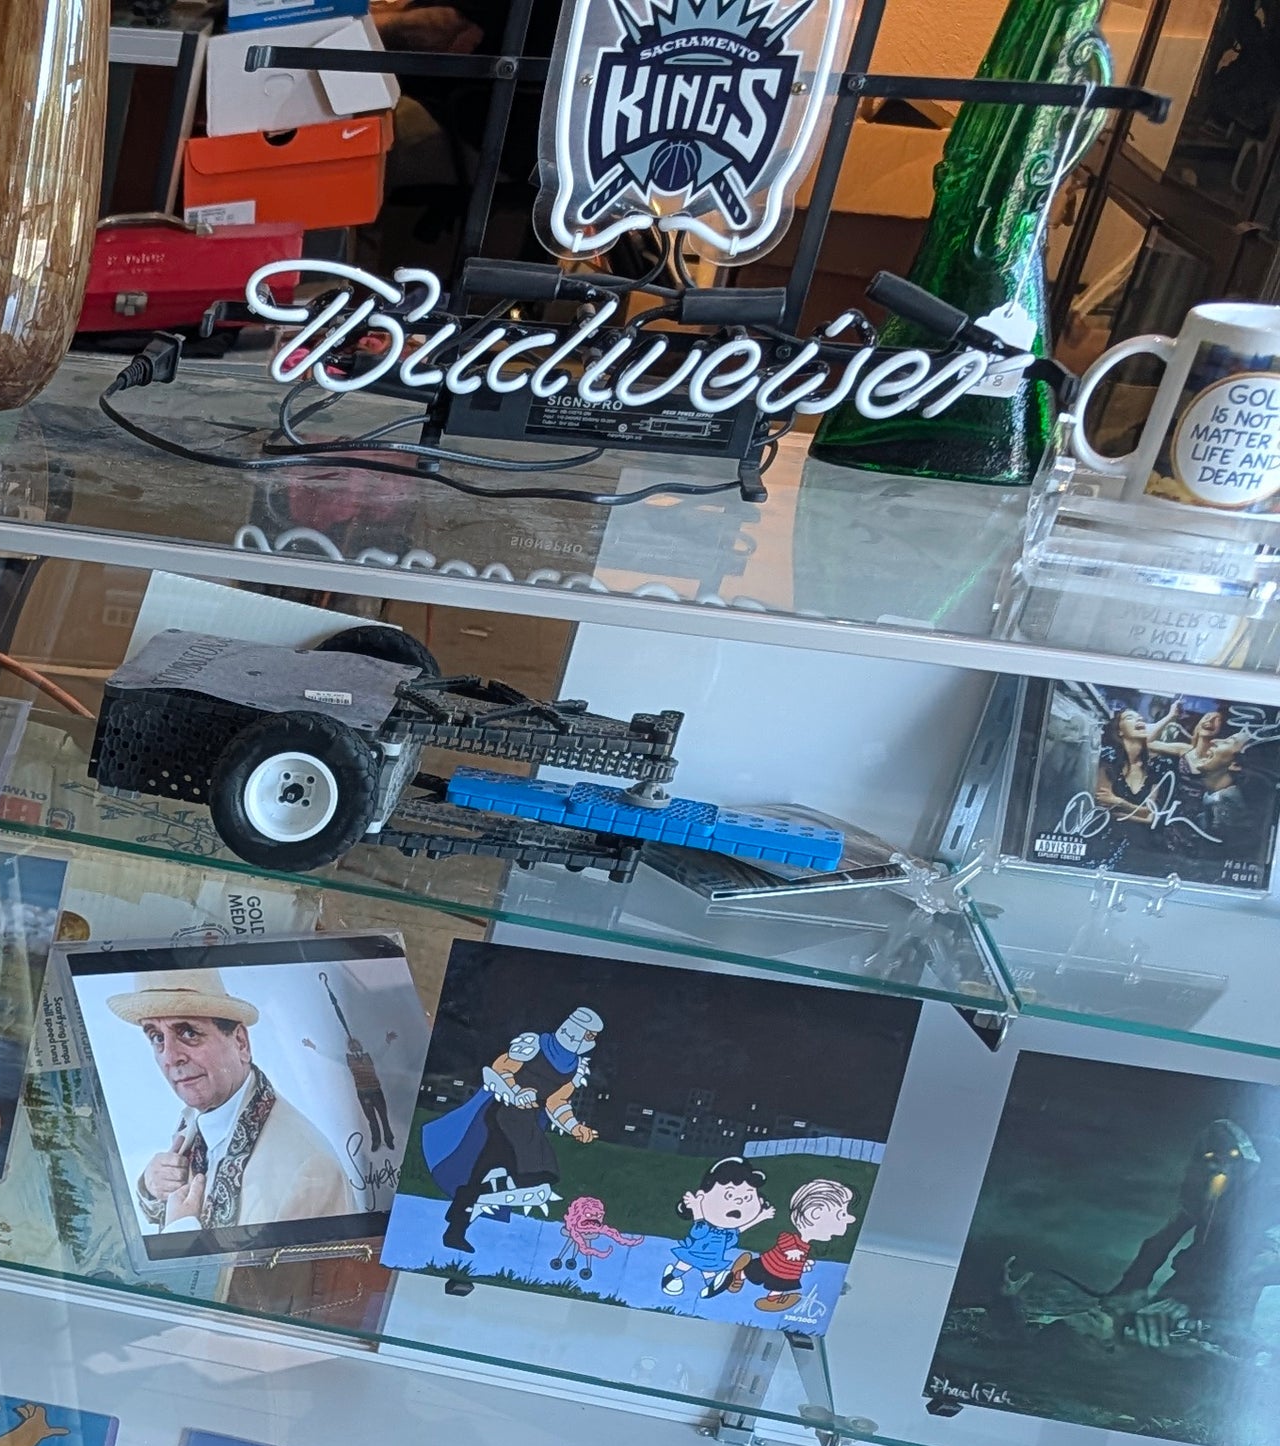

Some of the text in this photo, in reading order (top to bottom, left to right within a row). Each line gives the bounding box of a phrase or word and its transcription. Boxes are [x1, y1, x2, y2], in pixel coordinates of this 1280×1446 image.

[639, 35, 761, 63] SACRAMENTO
[600, 65, 784, 164] KINGS
[245, 258, 1036, 421] Budweiser
[547, 395, 624, 412] SIGNSPRO
[1227, 384, 1280, 411] GOL
[1210, 404, 1273, 430] IS NOT
[1190, 423, 1271, 449] MATTER
[1191, 442, 1280, 471] LIFE AND
[1197, 465, 1263, 491] DEATH
[1038, 841, 1085, 856] ADVISORY
[1040, 833, 1085, 844] PARENTAL
[1223, 859, 1259, 872] Haim
[227, 893, 248, 936] MÉDA
